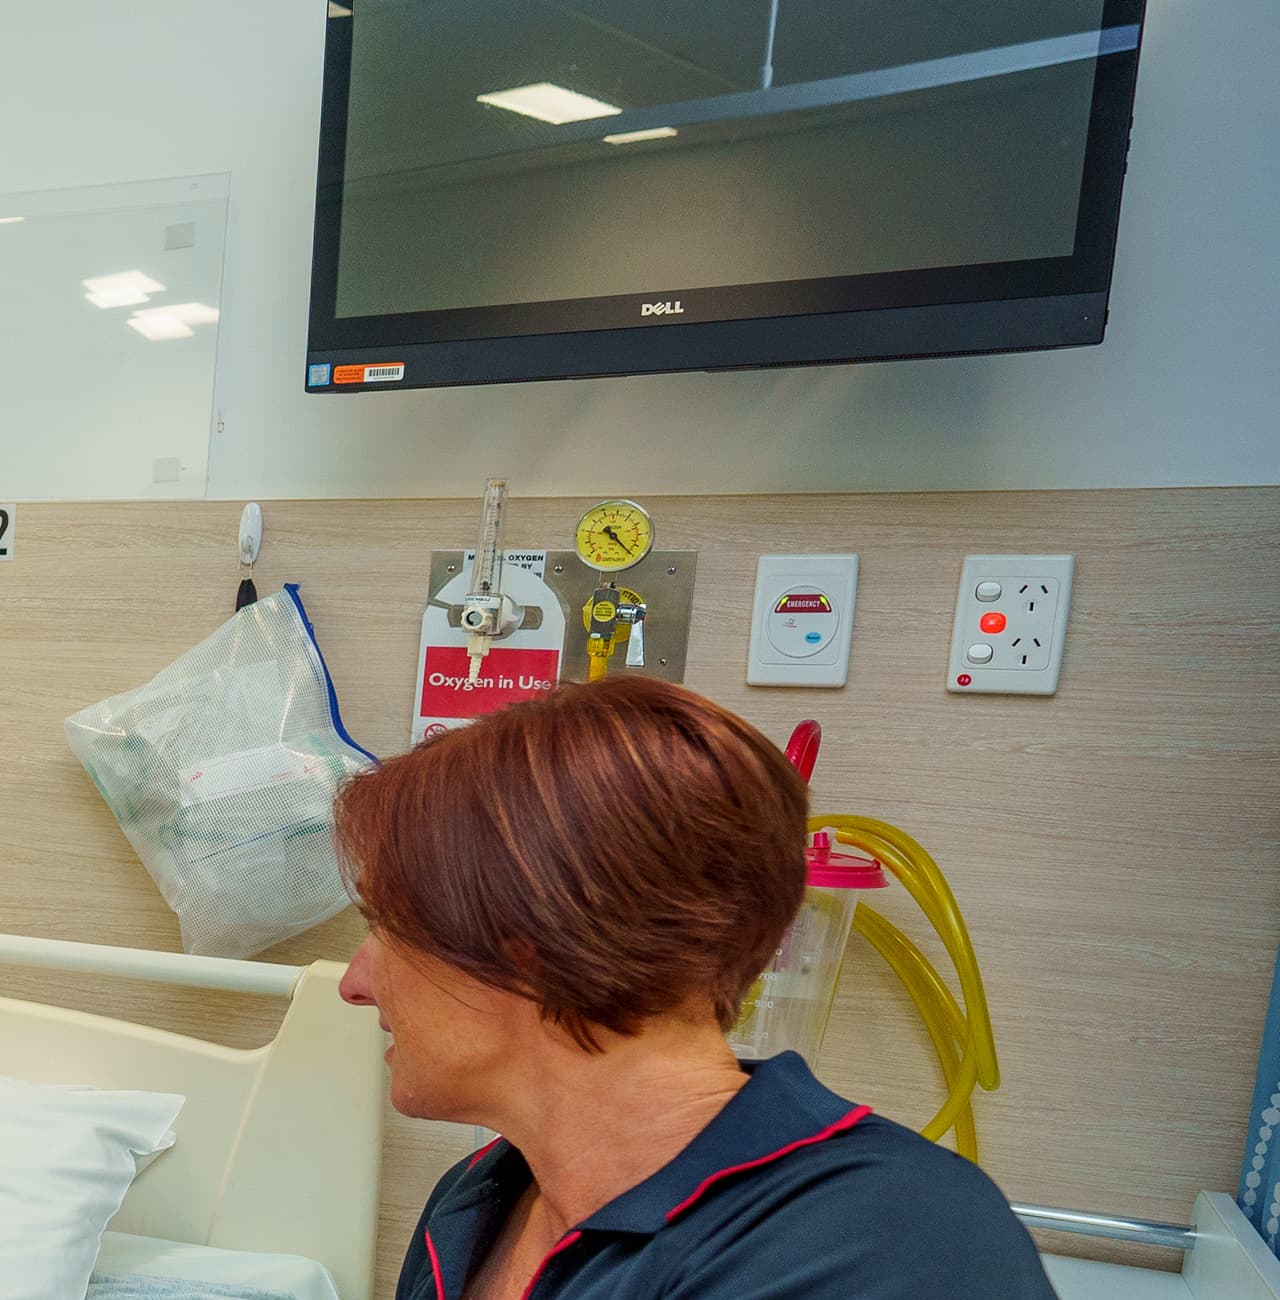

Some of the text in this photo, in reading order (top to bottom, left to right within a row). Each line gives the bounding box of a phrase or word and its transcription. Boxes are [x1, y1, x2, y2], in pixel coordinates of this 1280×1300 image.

[641, 301, 684, 316] DELL
[787, 600, 820, 608] EMERGENCY
[498, 675, 514, 689] in
[518, 675, 551, 690] Use
